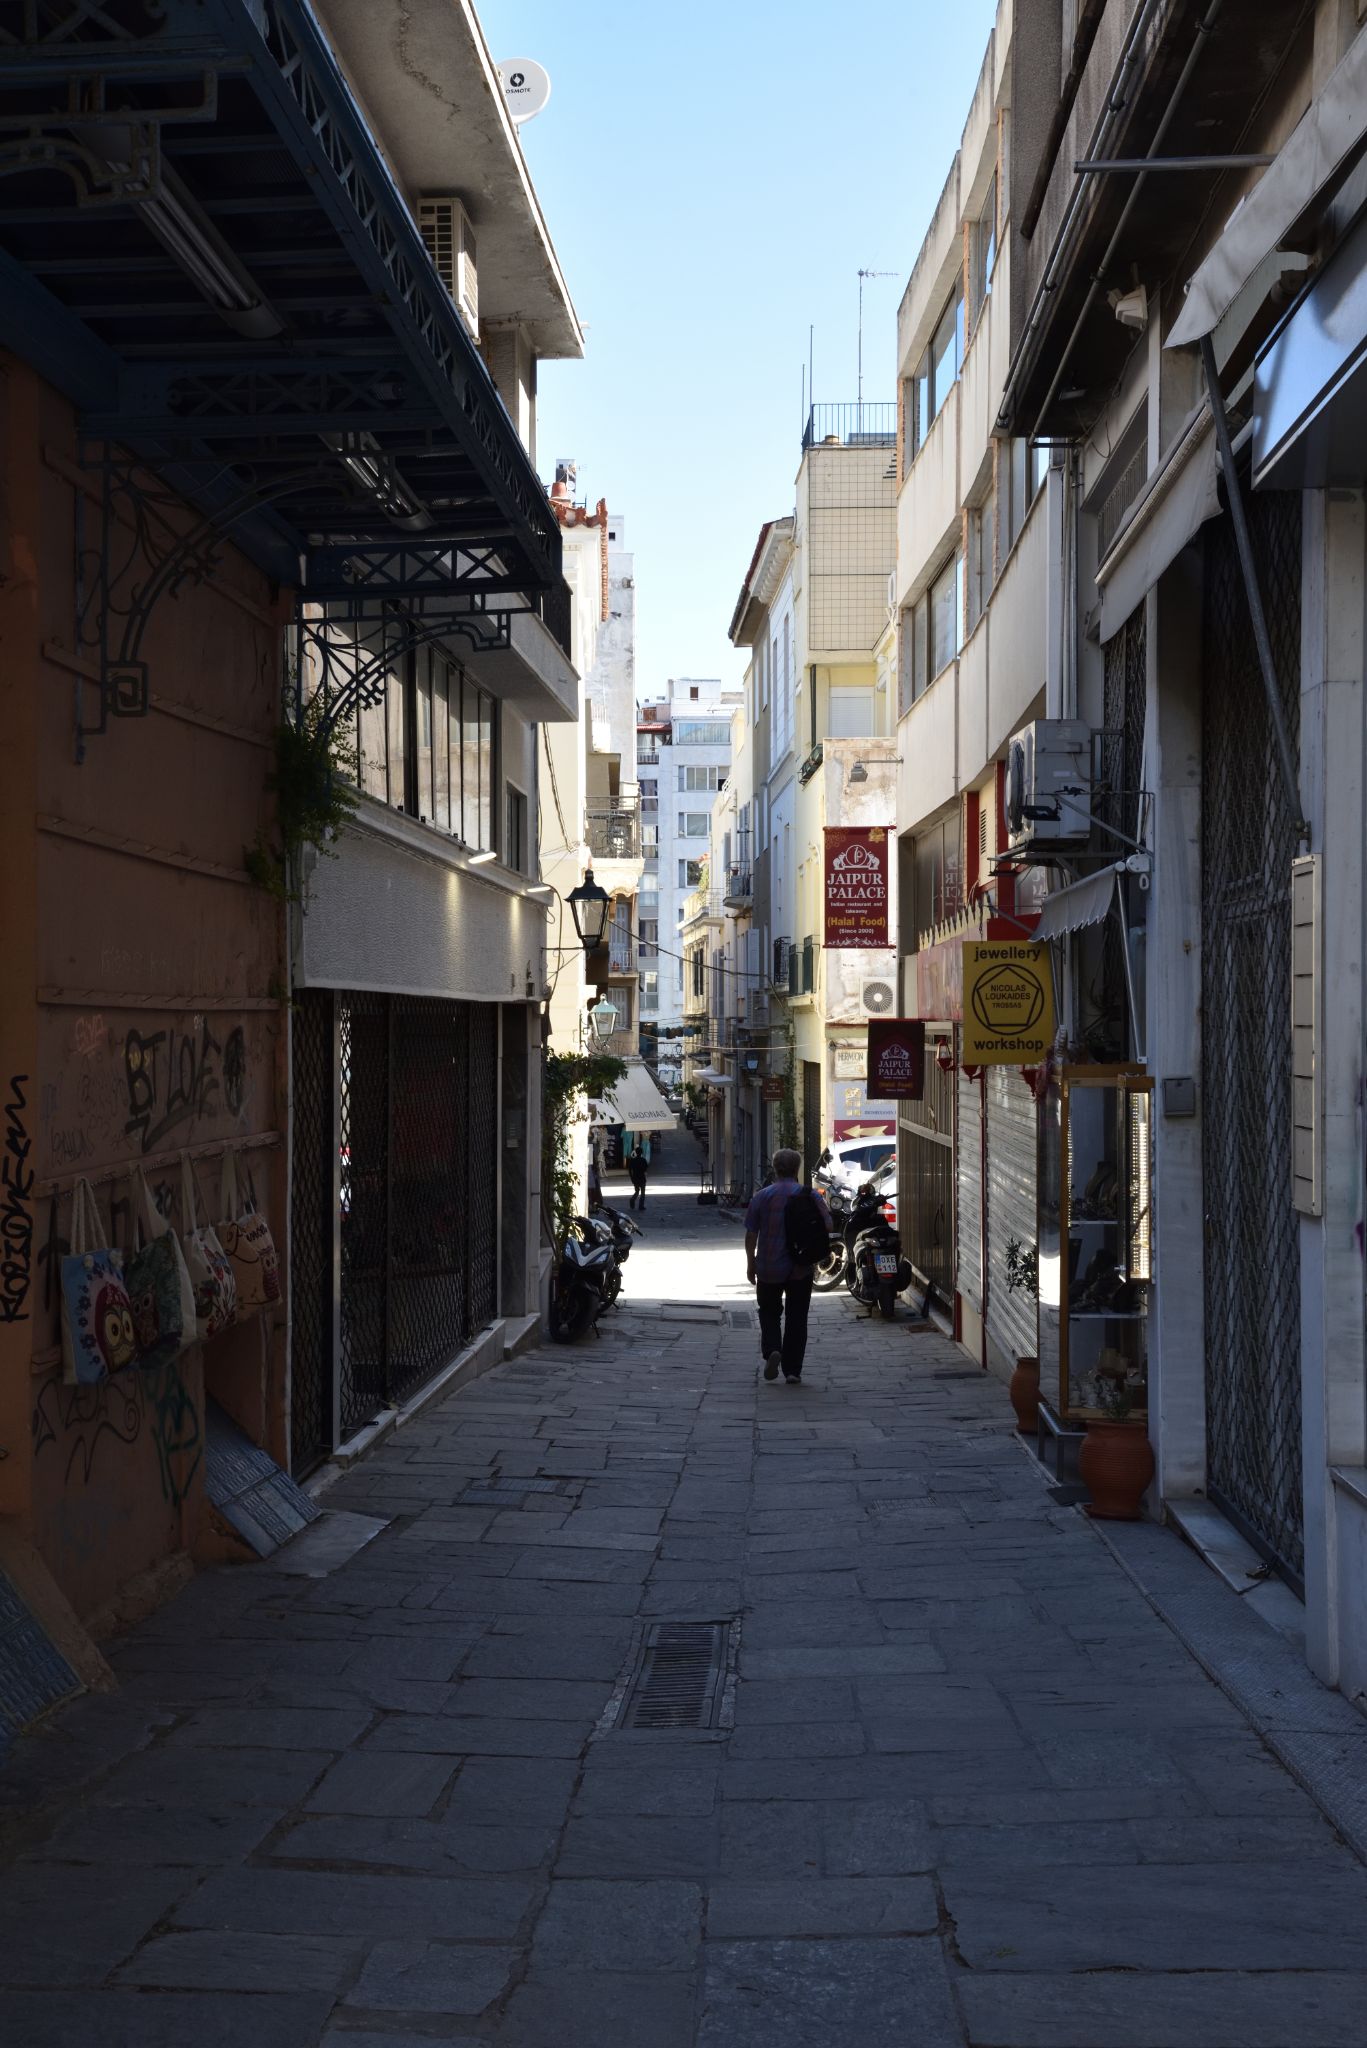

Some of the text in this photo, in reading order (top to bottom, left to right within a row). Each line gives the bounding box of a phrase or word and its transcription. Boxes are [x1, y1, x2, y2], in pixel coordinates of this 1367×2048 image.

[827, 873, 883, 885] JAIPUR
[828, 887, 886, 898] PALACE
[827, 917, 886, 928] (Halal Food)
[974, 946, 1041, 962] jewellery
[990, 984, 1027, 992] NICOLAS
[985, 992, 1031, 1001] LOUKAIDES
[973, 1037, 1044, 1053] workshop
[878, 1060, 911, 1068] JAIPUR
[878, 1068, 913, 1076] PALACE
[882, 1264, 897, 1272] 112
